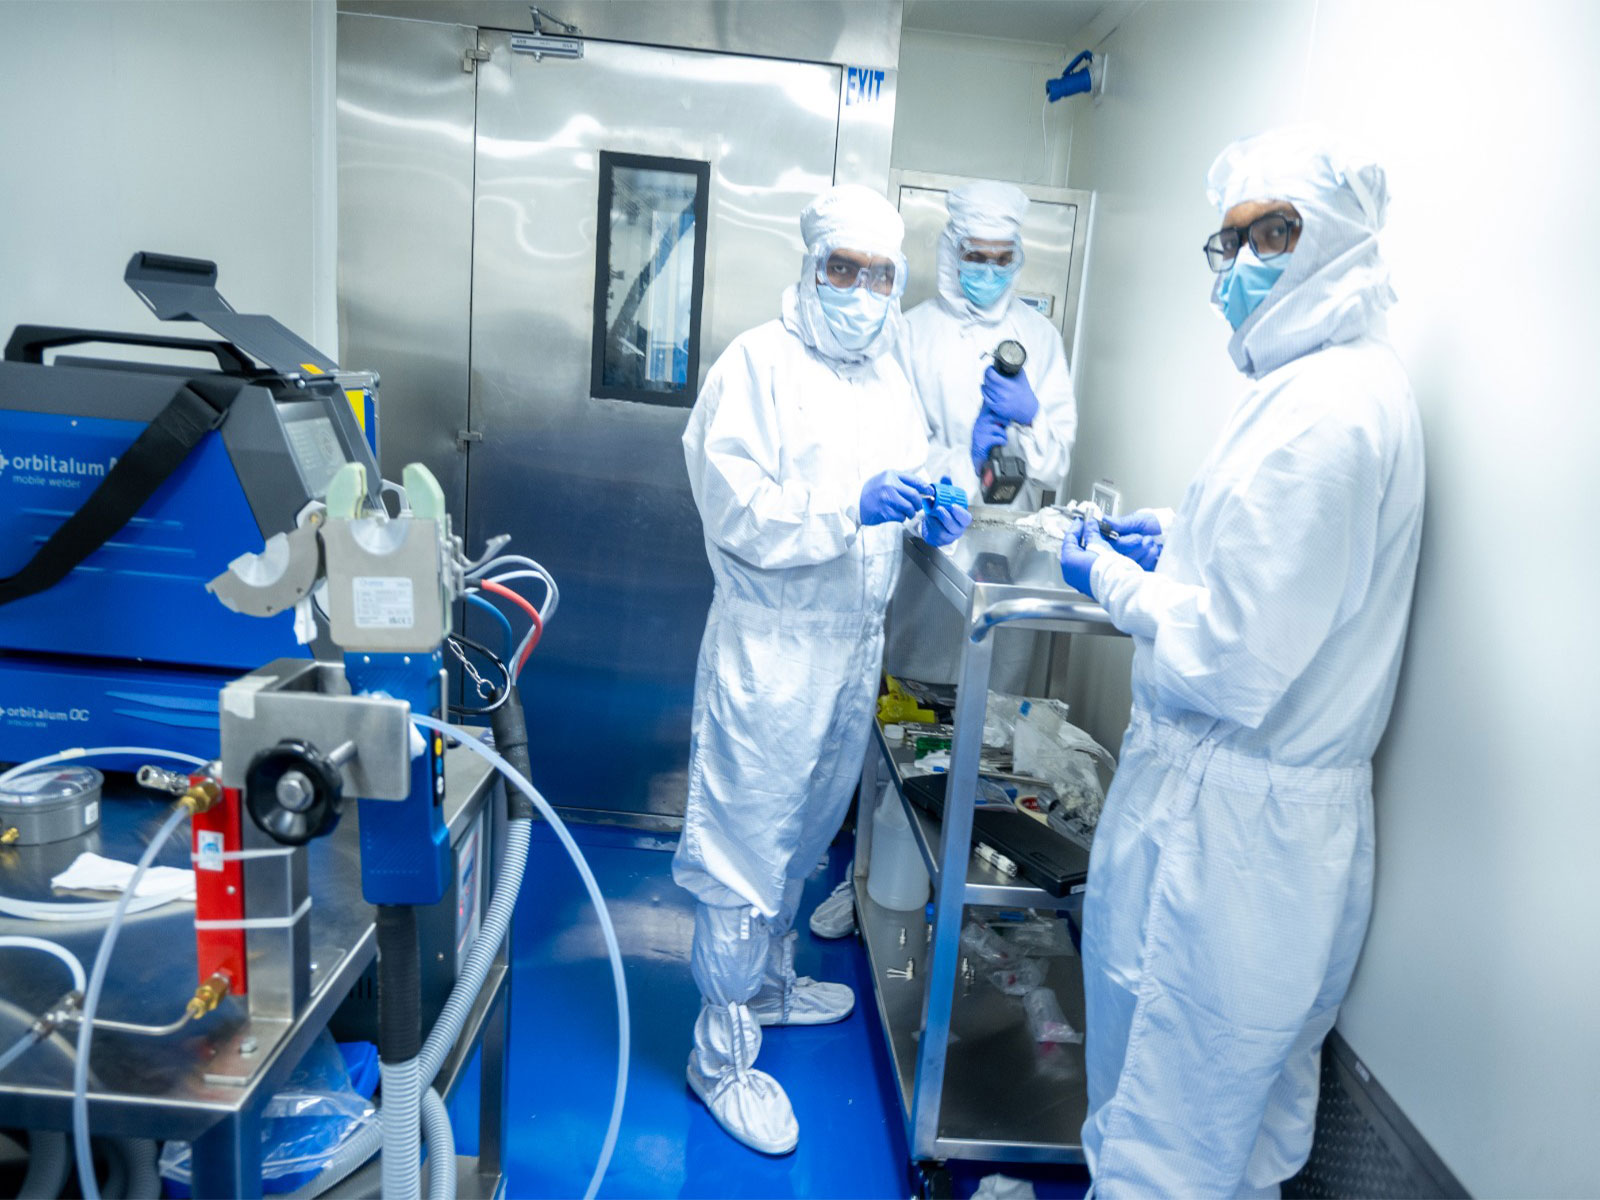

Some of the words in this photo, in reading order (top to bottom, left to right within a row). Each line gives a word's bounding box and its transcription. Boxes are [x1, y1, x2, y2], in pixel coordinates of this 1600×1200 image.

[845, 66, 885, 106] EXIT
[12, 454, 105, 476] orbitalum
[12, 475, 45, 486] mobile
[48, 478, 81, 488] welder
[7, 706, 68, 721] orbitalum
